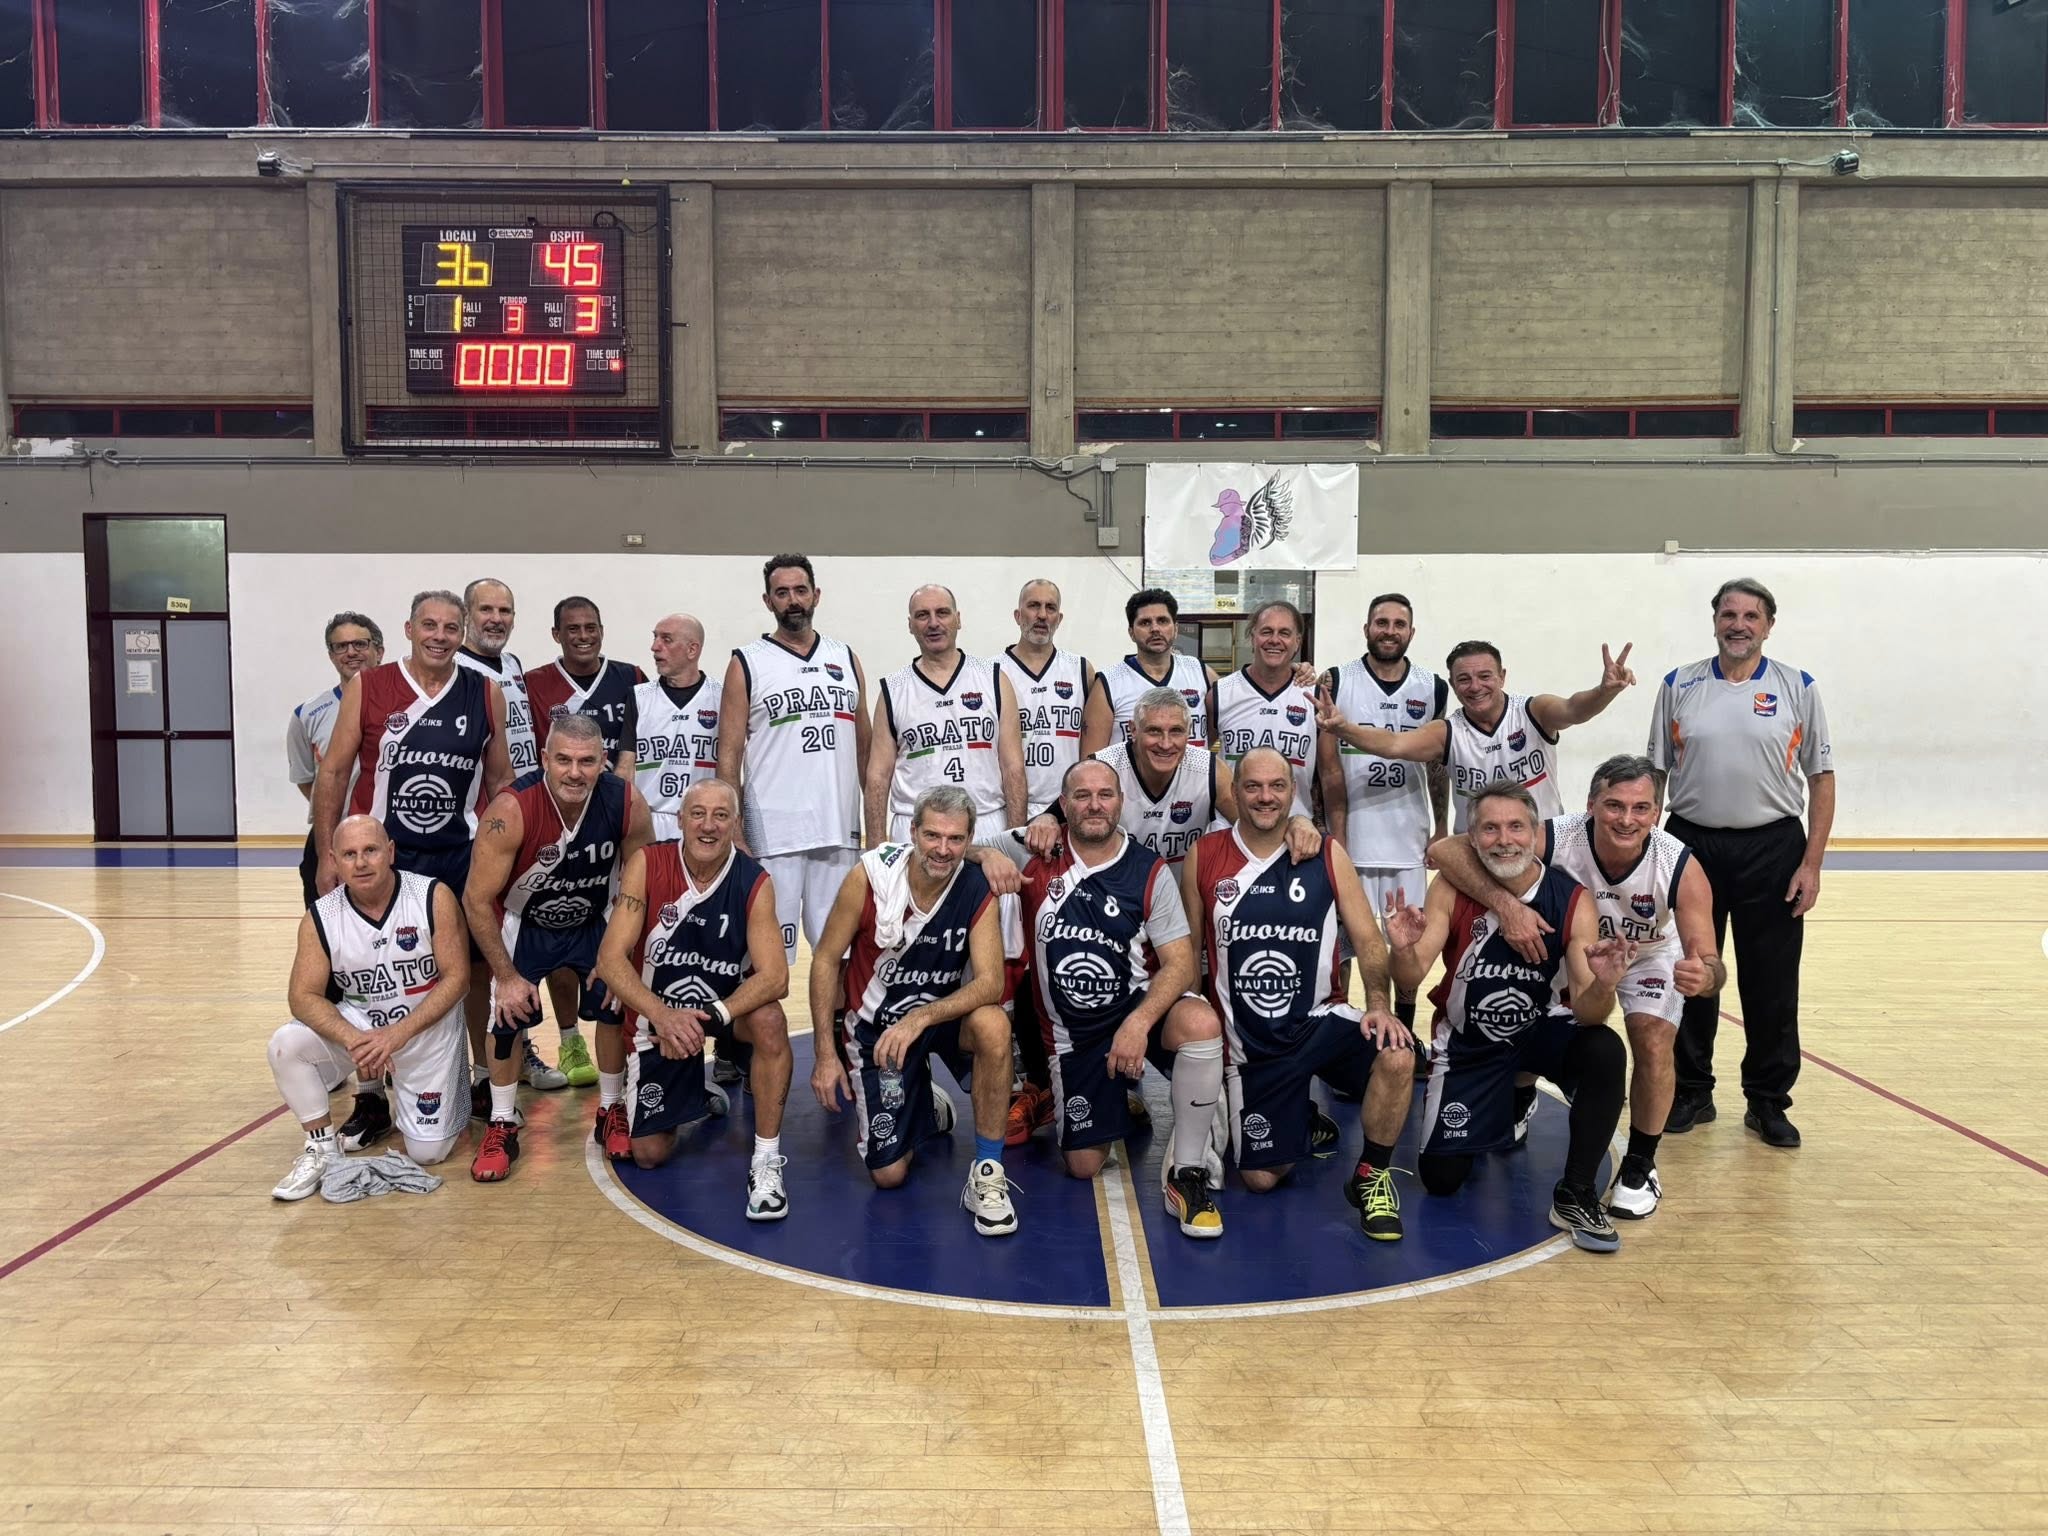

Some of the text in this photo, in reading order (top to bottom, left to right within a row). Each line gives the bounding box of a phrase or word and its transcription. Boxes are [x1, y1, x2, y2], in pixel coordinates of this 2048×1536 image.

[440, 230, 476, 242] LOCALI
[550, 231, 584, 242] OSPITI
[544, 244, 598, 286] 45
[463, 302, 481, 313] FALLI
[499, 296, 527, 304] PERIODO
[544, 302, 563, 314] FALLI
[453, 295, 462, 332] 1
[463, 316, 476, 327] SET
[507, 306, 522, 332] 3
[576, 297, 598, 331] 3
[549, 317, 562, 328] SET
[409, 349, 443, 359] TIME OUT
[586, 349, 620, 359] TIME OUT
[764, 686, 858, 719] PRATO
[602, 703, 625, 722] 13
[1019, 705, 1082, 730] RATO
[428, 719, 442, 727] IKS
[455, 715, 468, 736] 9
[802, 724, 836, 753] 20
[903, 717, 995, 751] PRATO
[1223, 729, 1311, 759] PRATO
[378, 741, 475, 772] Livorno
[510, 740, 538, 769] 21
[1026, 743, 1054, 766] 10
[944, 757, 965, 782] 4
[1368, 762, 1406, 787] 23
[1455, 749, 1545, 791] PRATO
[660, 773, 690, 798] 61
[392, 798, 457, 810] NAUTILUS
[585, 841, 614, 864] 10
[1259, 885, 1275, 894] IKS
[1289, 877, 1306, 902] 6
[529, 908, 593, 921] NAUTILU
[1104, 895, 1121, 917] 8
[719, 914, 730, 939] 7
[1217, 915, 1320, 949] Livorno
[924, 936, 938, 944] IKS
[645, 938, 741, 976] Livorno
[1054, 975, 1121, 991] NAUTILUS
[371, 990, 399, 1002] ITALIA
[1645, 991, 1661, 999] IKS
[1471, 1009, 1542, 1024] NAUTILUS
[425, 1117, 439, 1125] IKS
[1441, 1111, 1472, 1119] NAUTILUS
[1080, 1119, 1093, 1129] IKS
[885, 1135, 898, 1146] IKS
[1452, 1130, 1468, 1138] IKS
[1260, 1140, 1274, 1149] IKS
